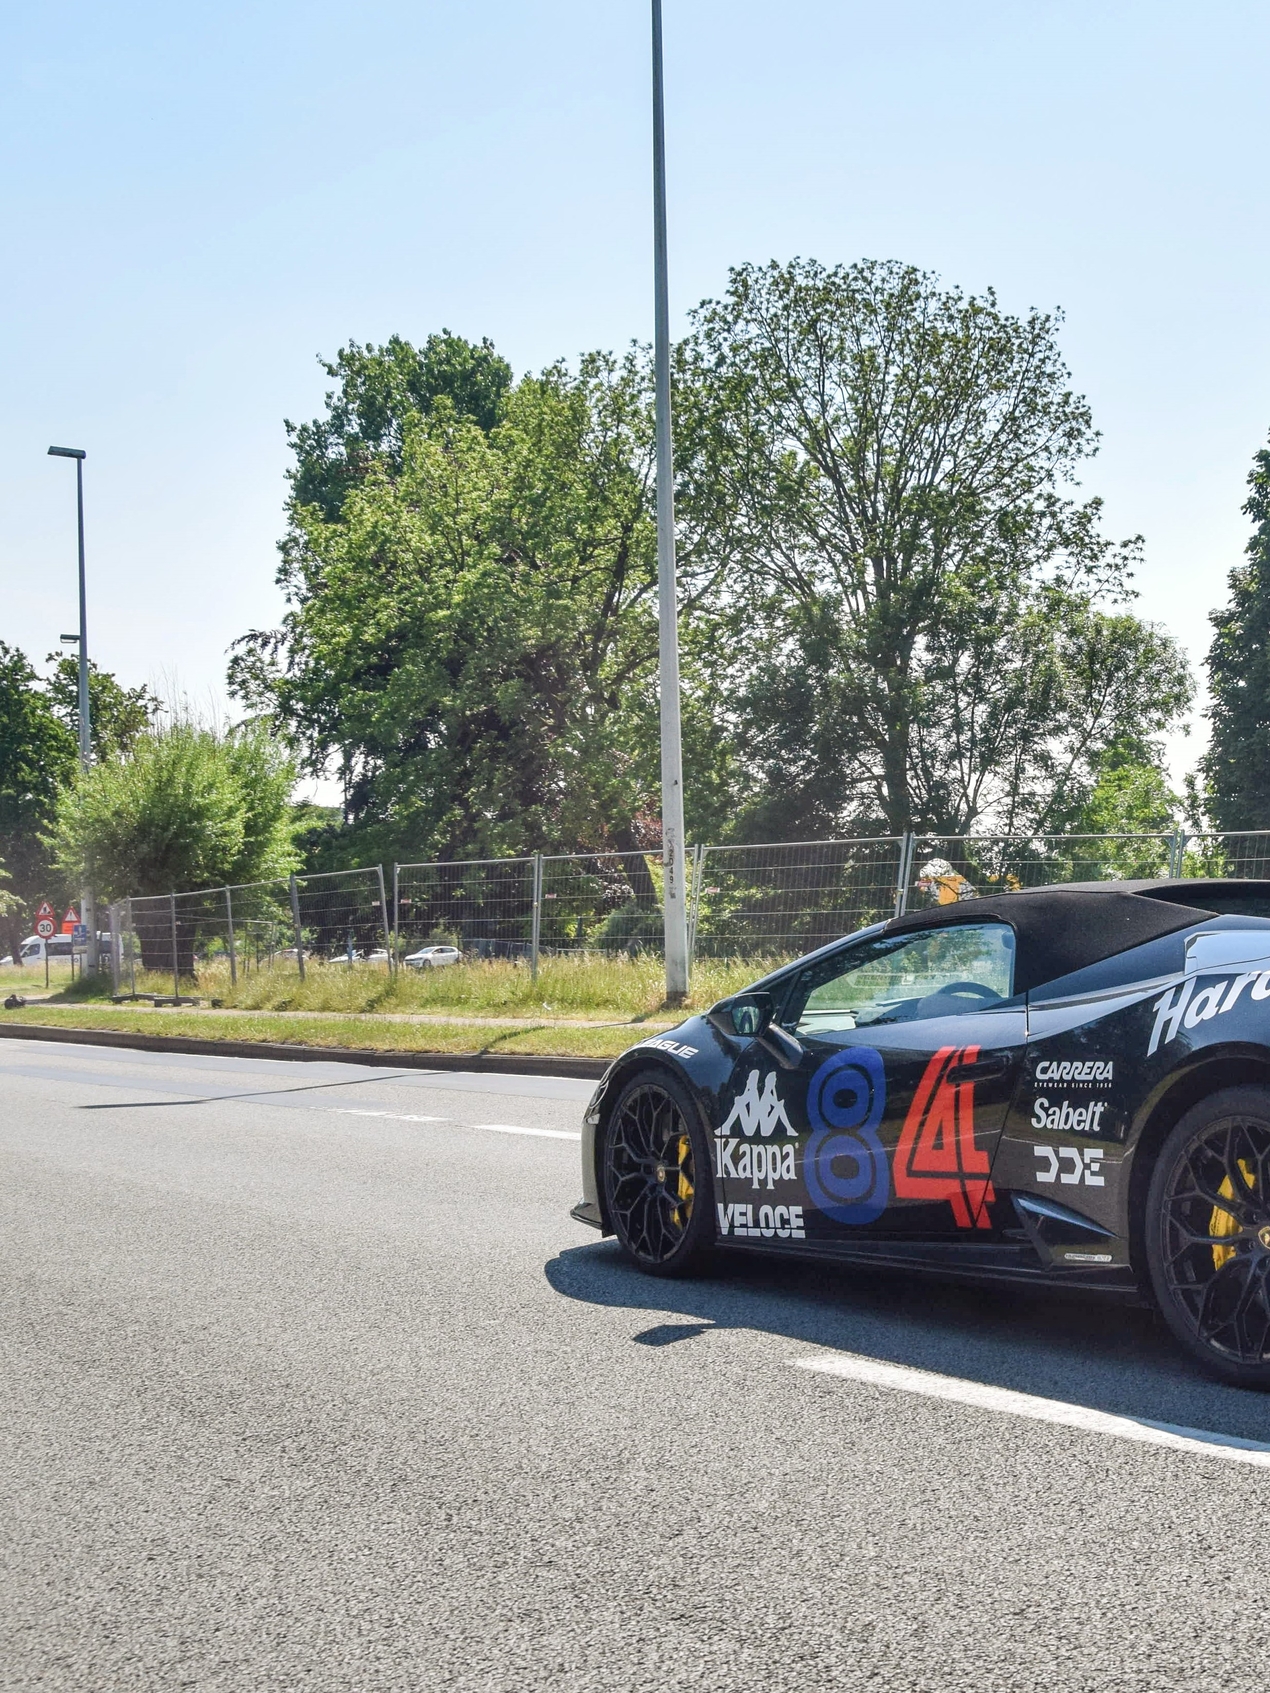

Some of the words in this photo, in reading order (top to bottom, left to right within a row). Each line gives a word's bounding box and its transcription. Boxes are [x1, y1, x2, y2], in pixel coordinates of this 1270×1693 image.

[39, 923, 52, 933] 30
[1035, 1061, 1114, 1081] CARRERA
[1031, 1097, 1105, 1131] Sabelt
[714, 1138, 799, 1190] Kappa
[717, 1203, 806, 1239] VELOCE
